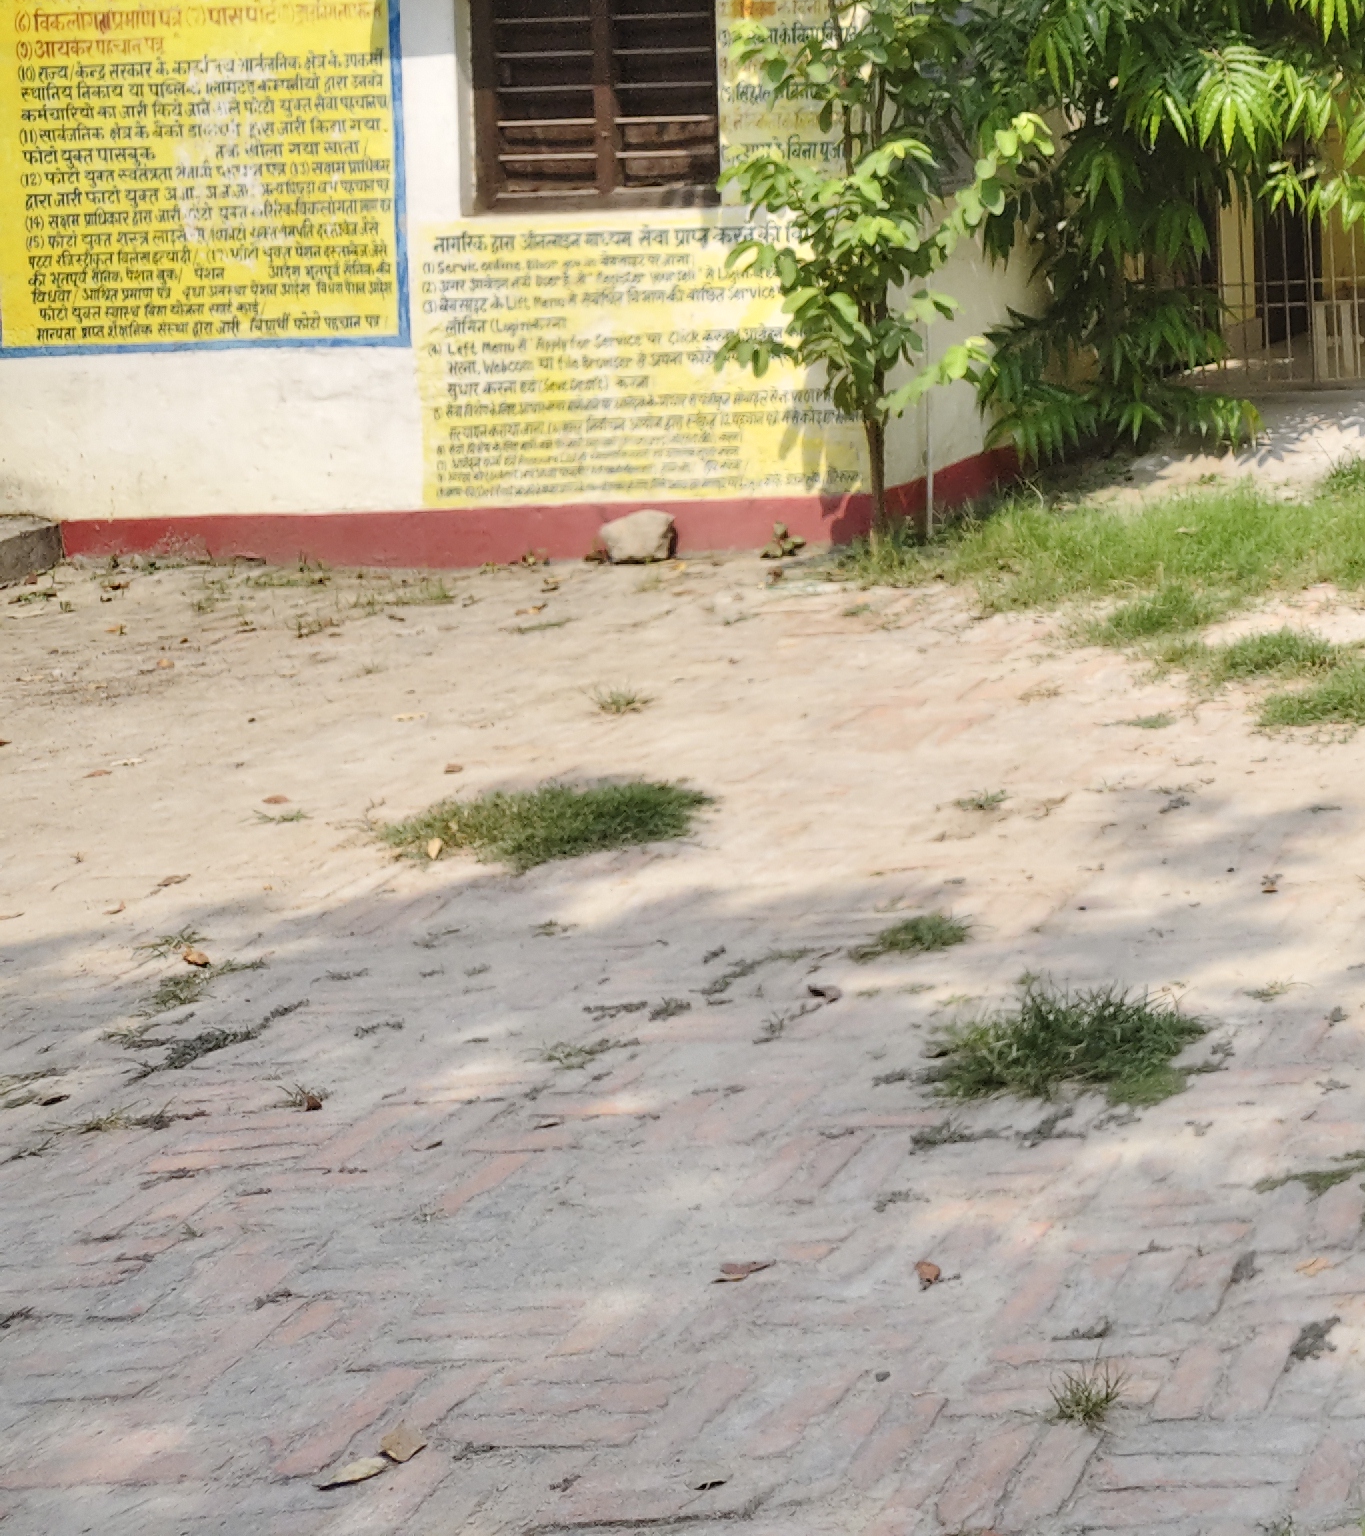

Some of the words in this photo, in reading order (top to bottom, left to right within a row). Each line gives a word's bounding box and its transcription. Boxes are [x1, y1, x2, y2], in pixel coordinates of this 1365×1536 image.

[109, 61, 152, 79] सरकार
[128, 82, 146, 99] या
[54, 187, 83, 209] जारी
